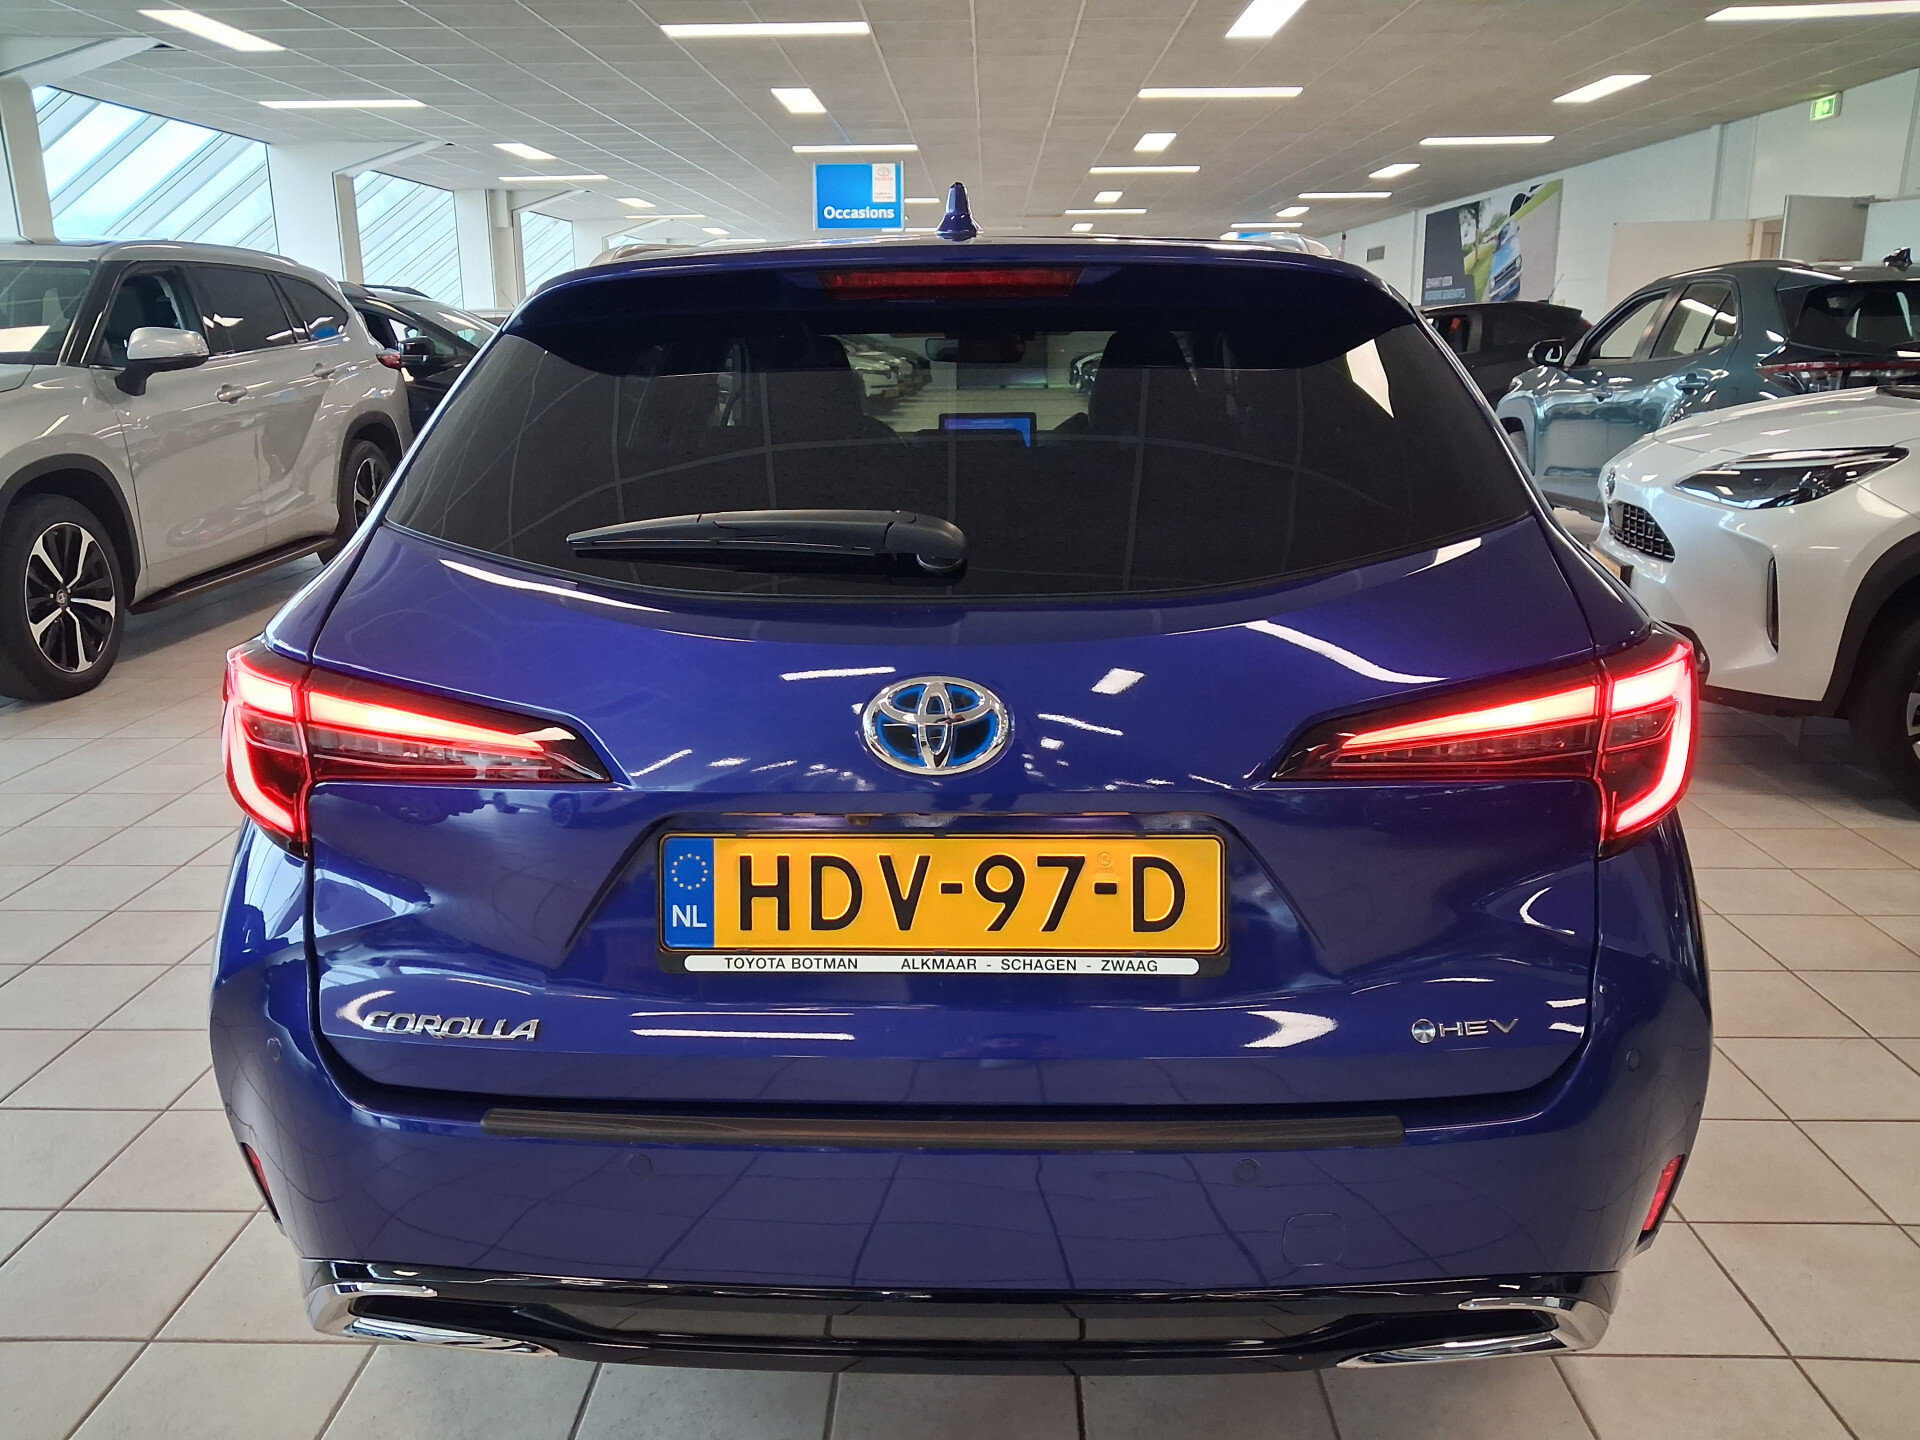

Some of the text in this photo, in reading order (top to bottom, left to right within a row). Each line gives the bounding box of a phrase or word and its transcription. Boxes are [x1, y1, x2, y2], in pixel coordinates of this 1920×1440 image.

[823, 205, 895, 219] Occasions
[739, 854, 1186, 931] HDV-97-D
[672, 904, 707, 928] NL
[724, 957, 858, 970] TOYOTA BOTMAN
[900, 958, 977, 970] ALKMAAR
[1000, 958, 1077, 971] SCHAGEN
[1101, 959, 1158, 972] ZWAAG
[363, 1010, 539, 1042] COROLLA
[1438, 1018, 1518, 1037] HEV
